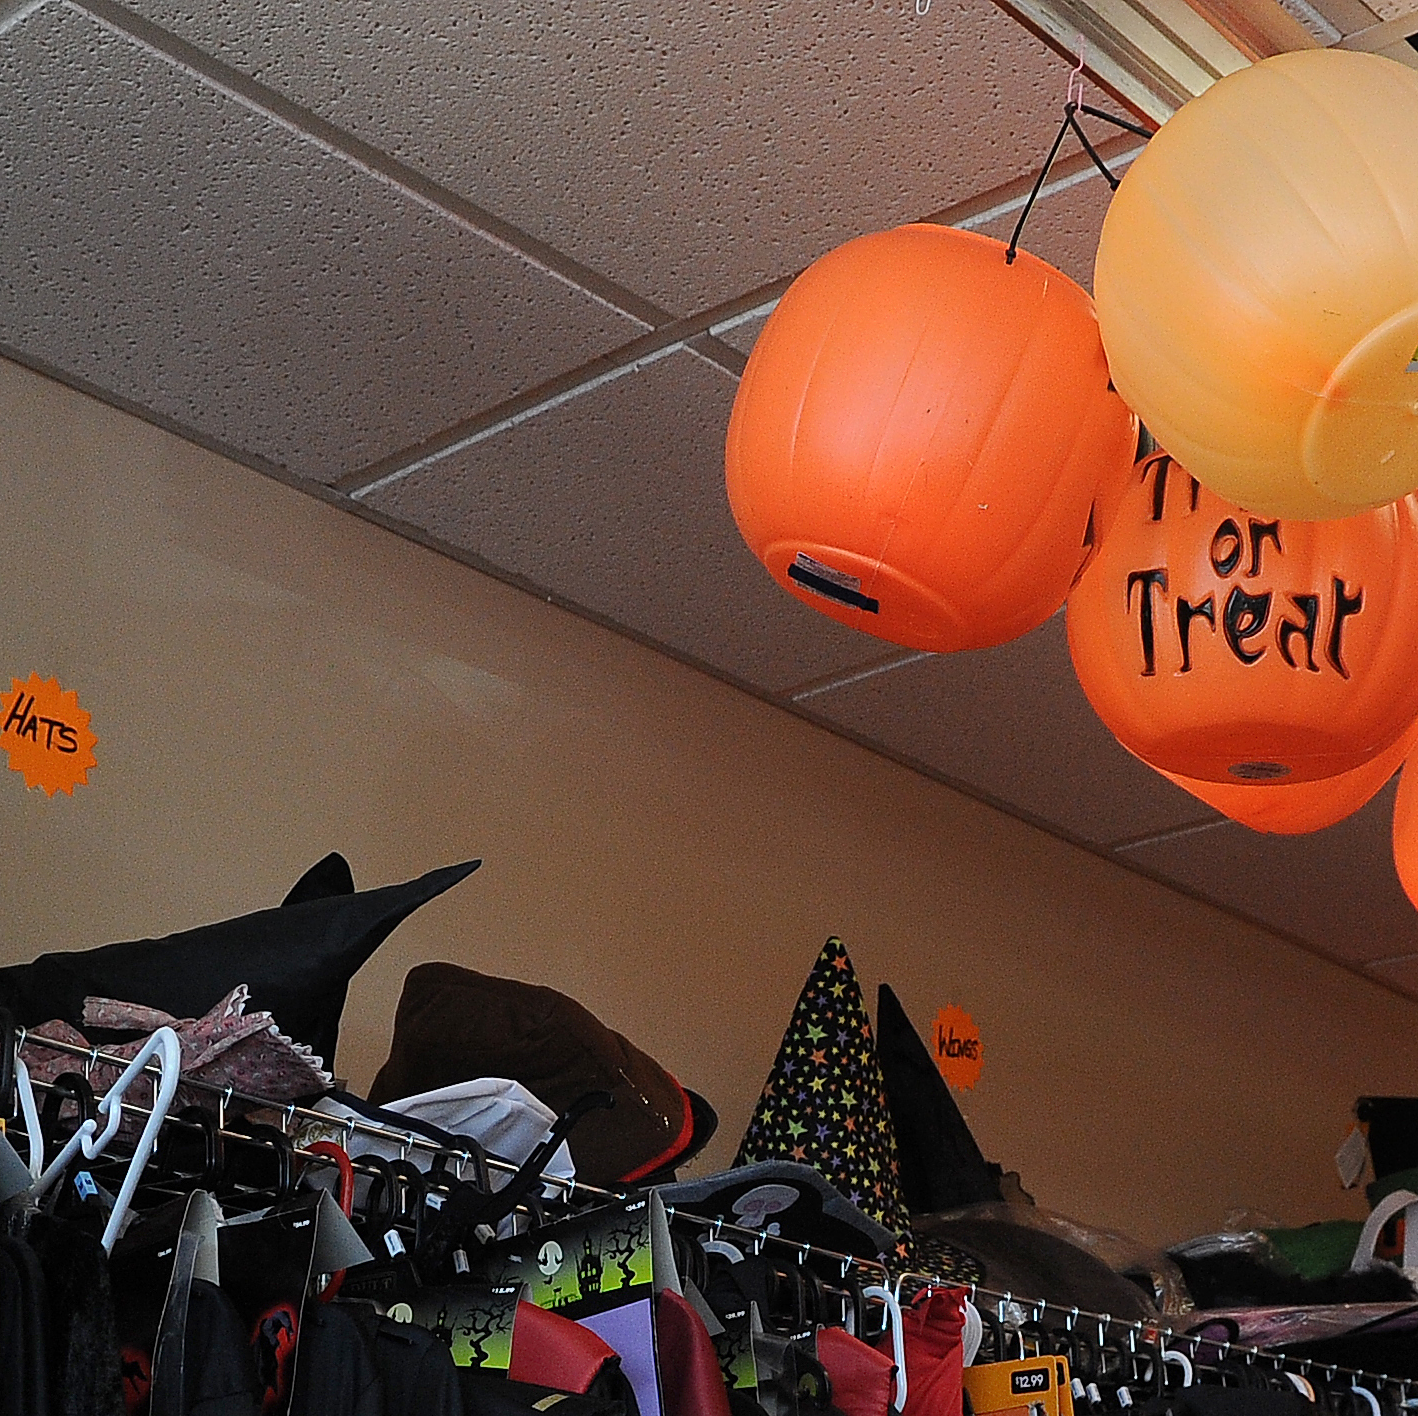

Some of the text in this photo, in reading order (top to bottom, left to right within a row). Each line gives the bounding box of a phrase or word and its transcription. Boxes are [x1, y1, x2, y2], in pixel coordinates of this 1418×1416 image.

[1209, 517, 1283, 578] or
[1127, 568, 1363, 681] Treat
[3, 692, 78, 753] HATS
[1015, 1373, 1044, 1389] $12.99
